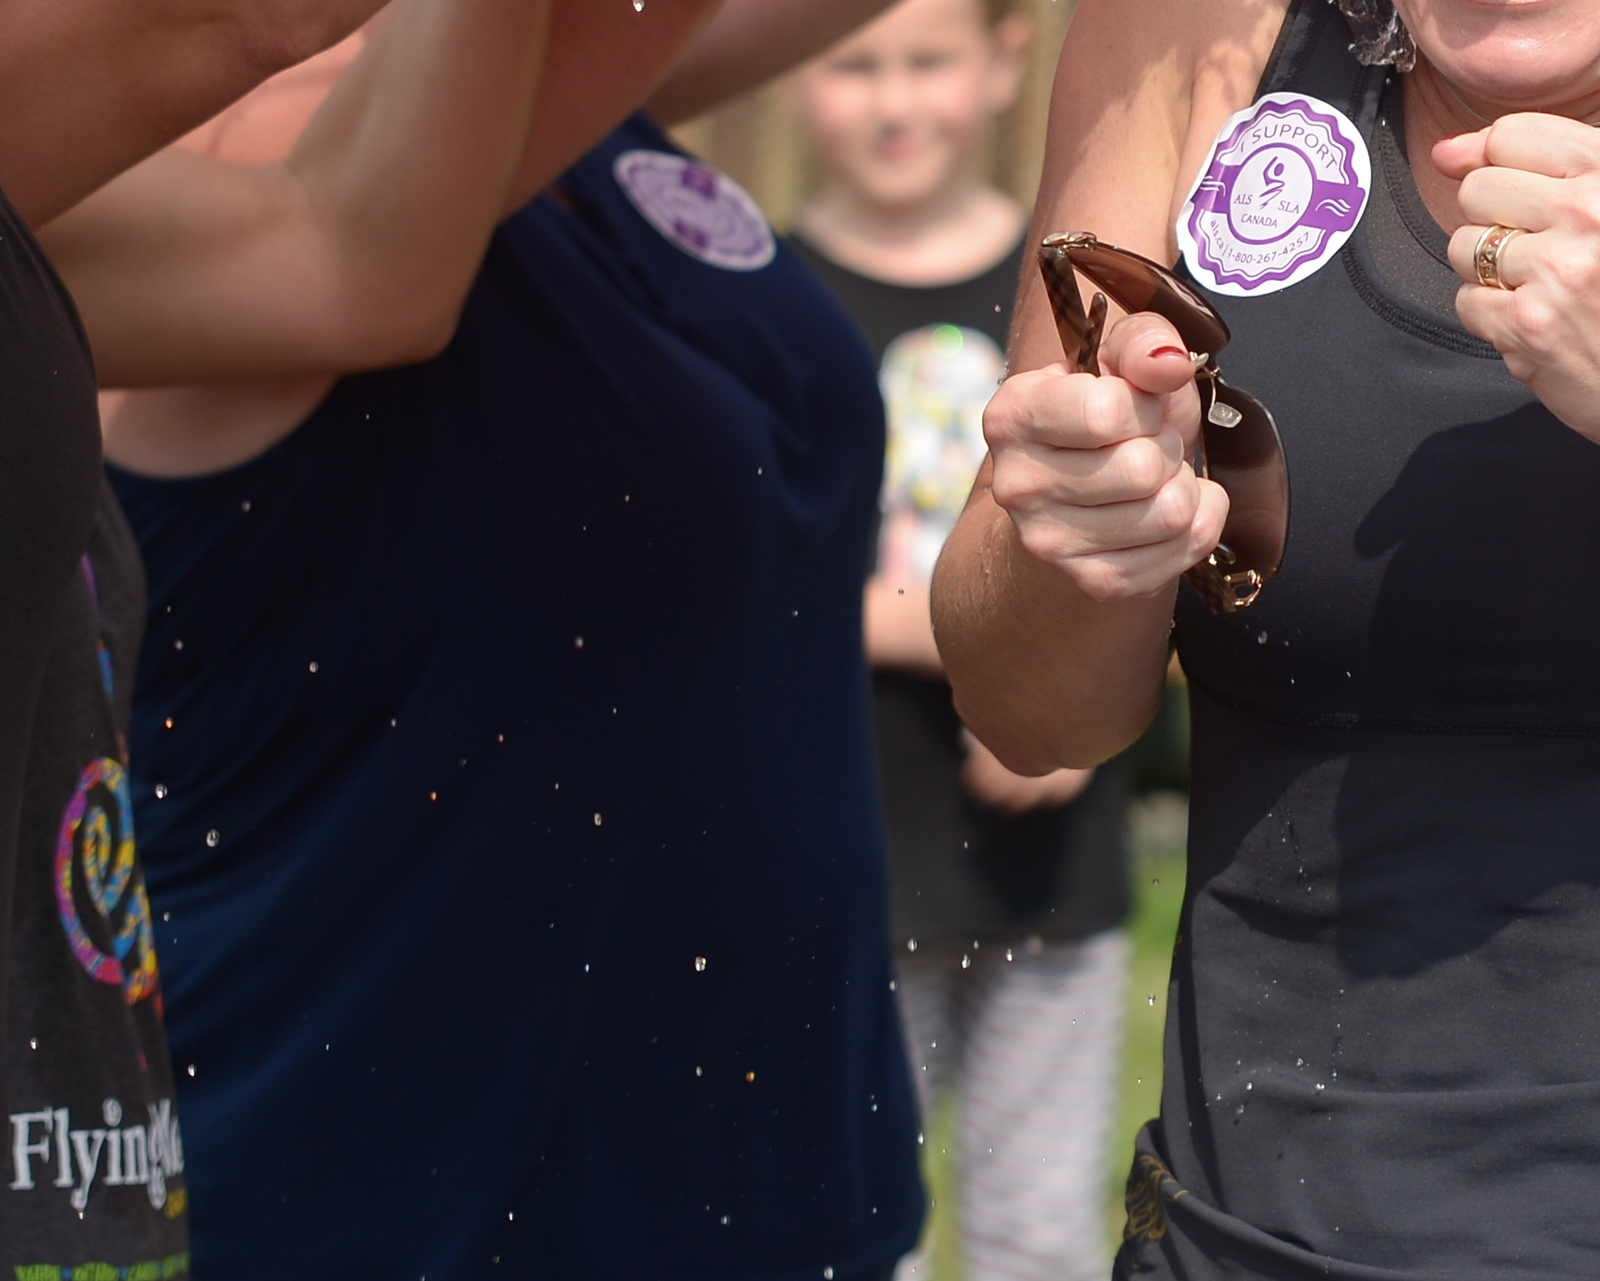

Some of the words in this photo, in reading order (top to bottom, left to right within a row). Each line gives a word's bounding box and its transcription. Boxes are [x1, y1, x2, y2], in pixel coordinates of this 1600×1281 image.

[1252, 124, 1338, 169] SUPPORT
[1233, 194, 1254, 205] ALS
[1278, 200, 1300, 214] SLA
[1240, 213, 1278, 228] CANADA
